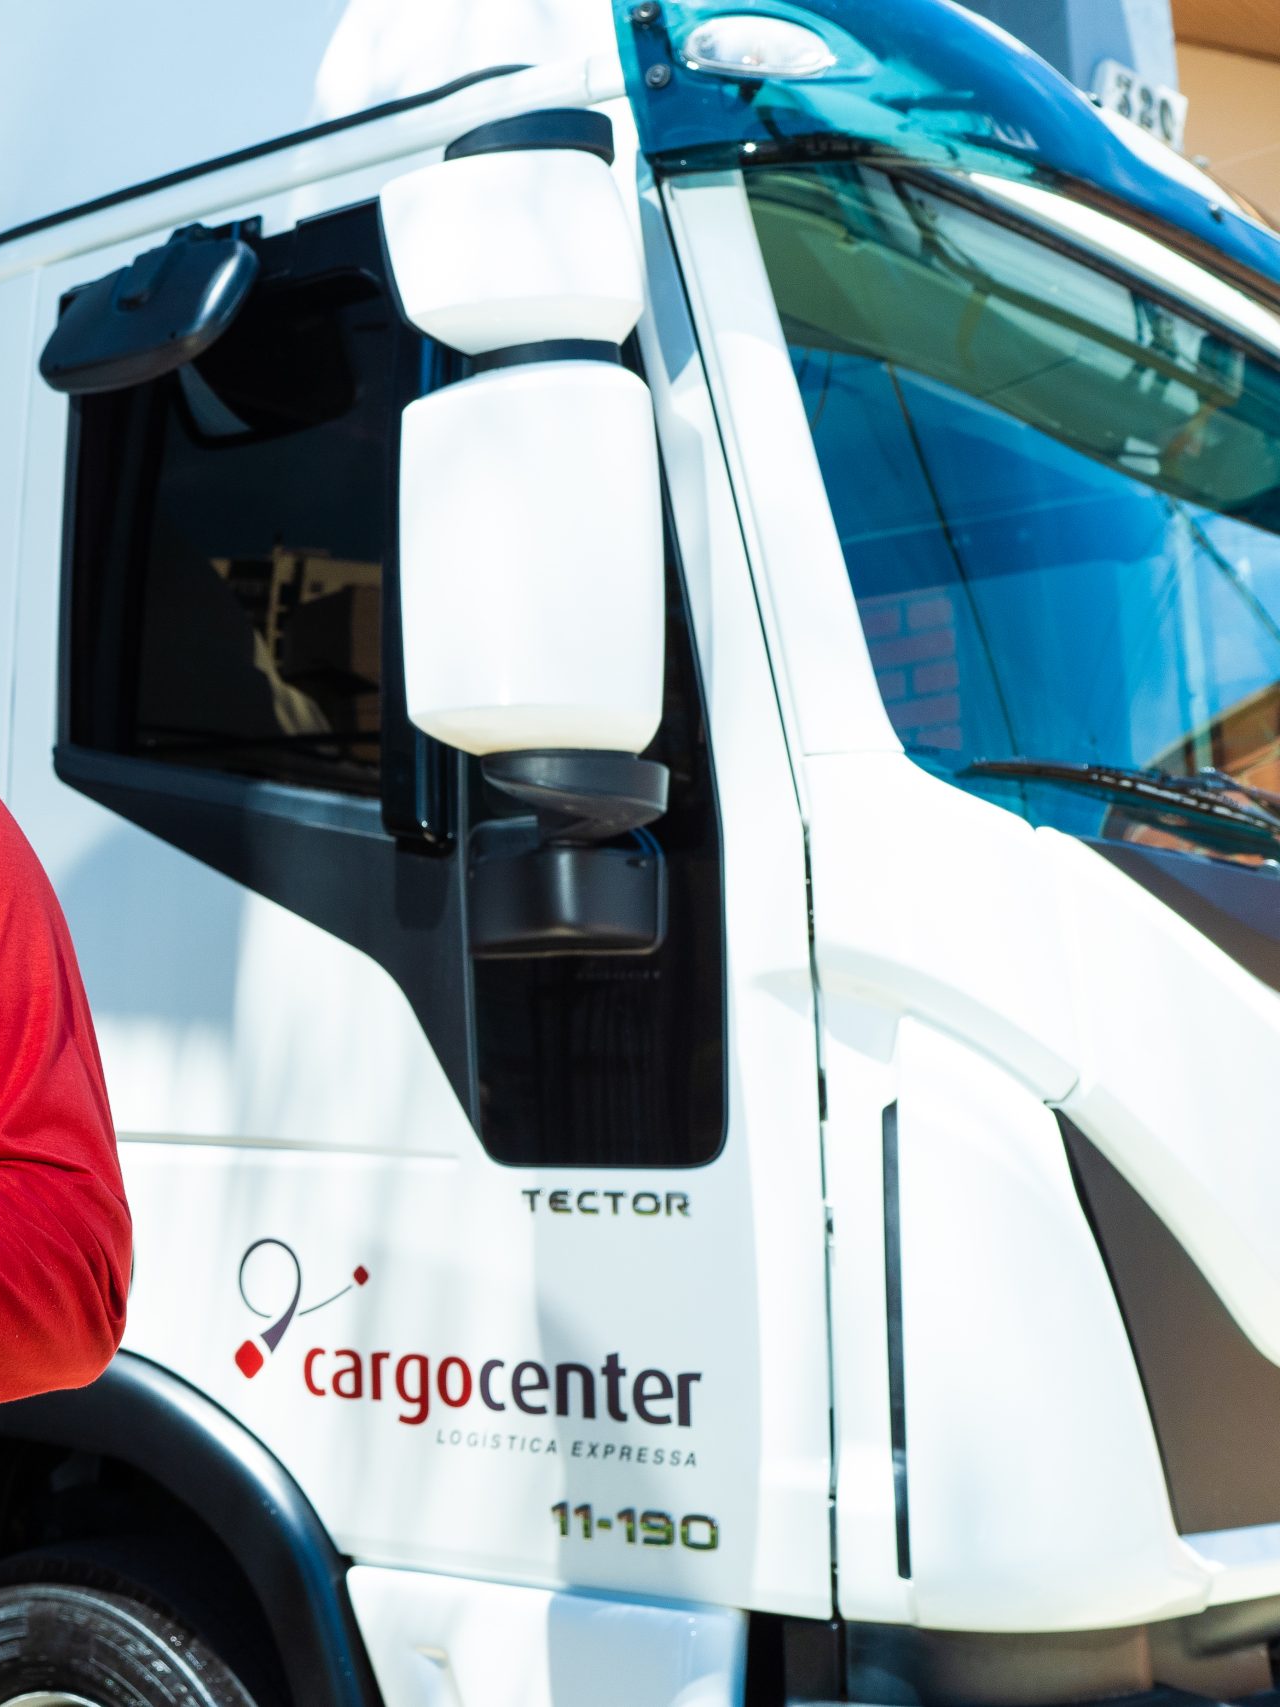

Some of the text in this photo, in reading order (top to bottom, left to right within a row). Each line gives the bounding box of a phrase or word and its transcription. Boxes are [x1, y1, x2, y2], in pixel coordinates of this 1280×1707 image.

[522, 1188, 691, 1217] TECTOR
[303, 1347, 702, 1427] cargocenter
[570, 1441, 698, 1468] EXPRESSA
[550, 1501, 719, 1551] 11-190
